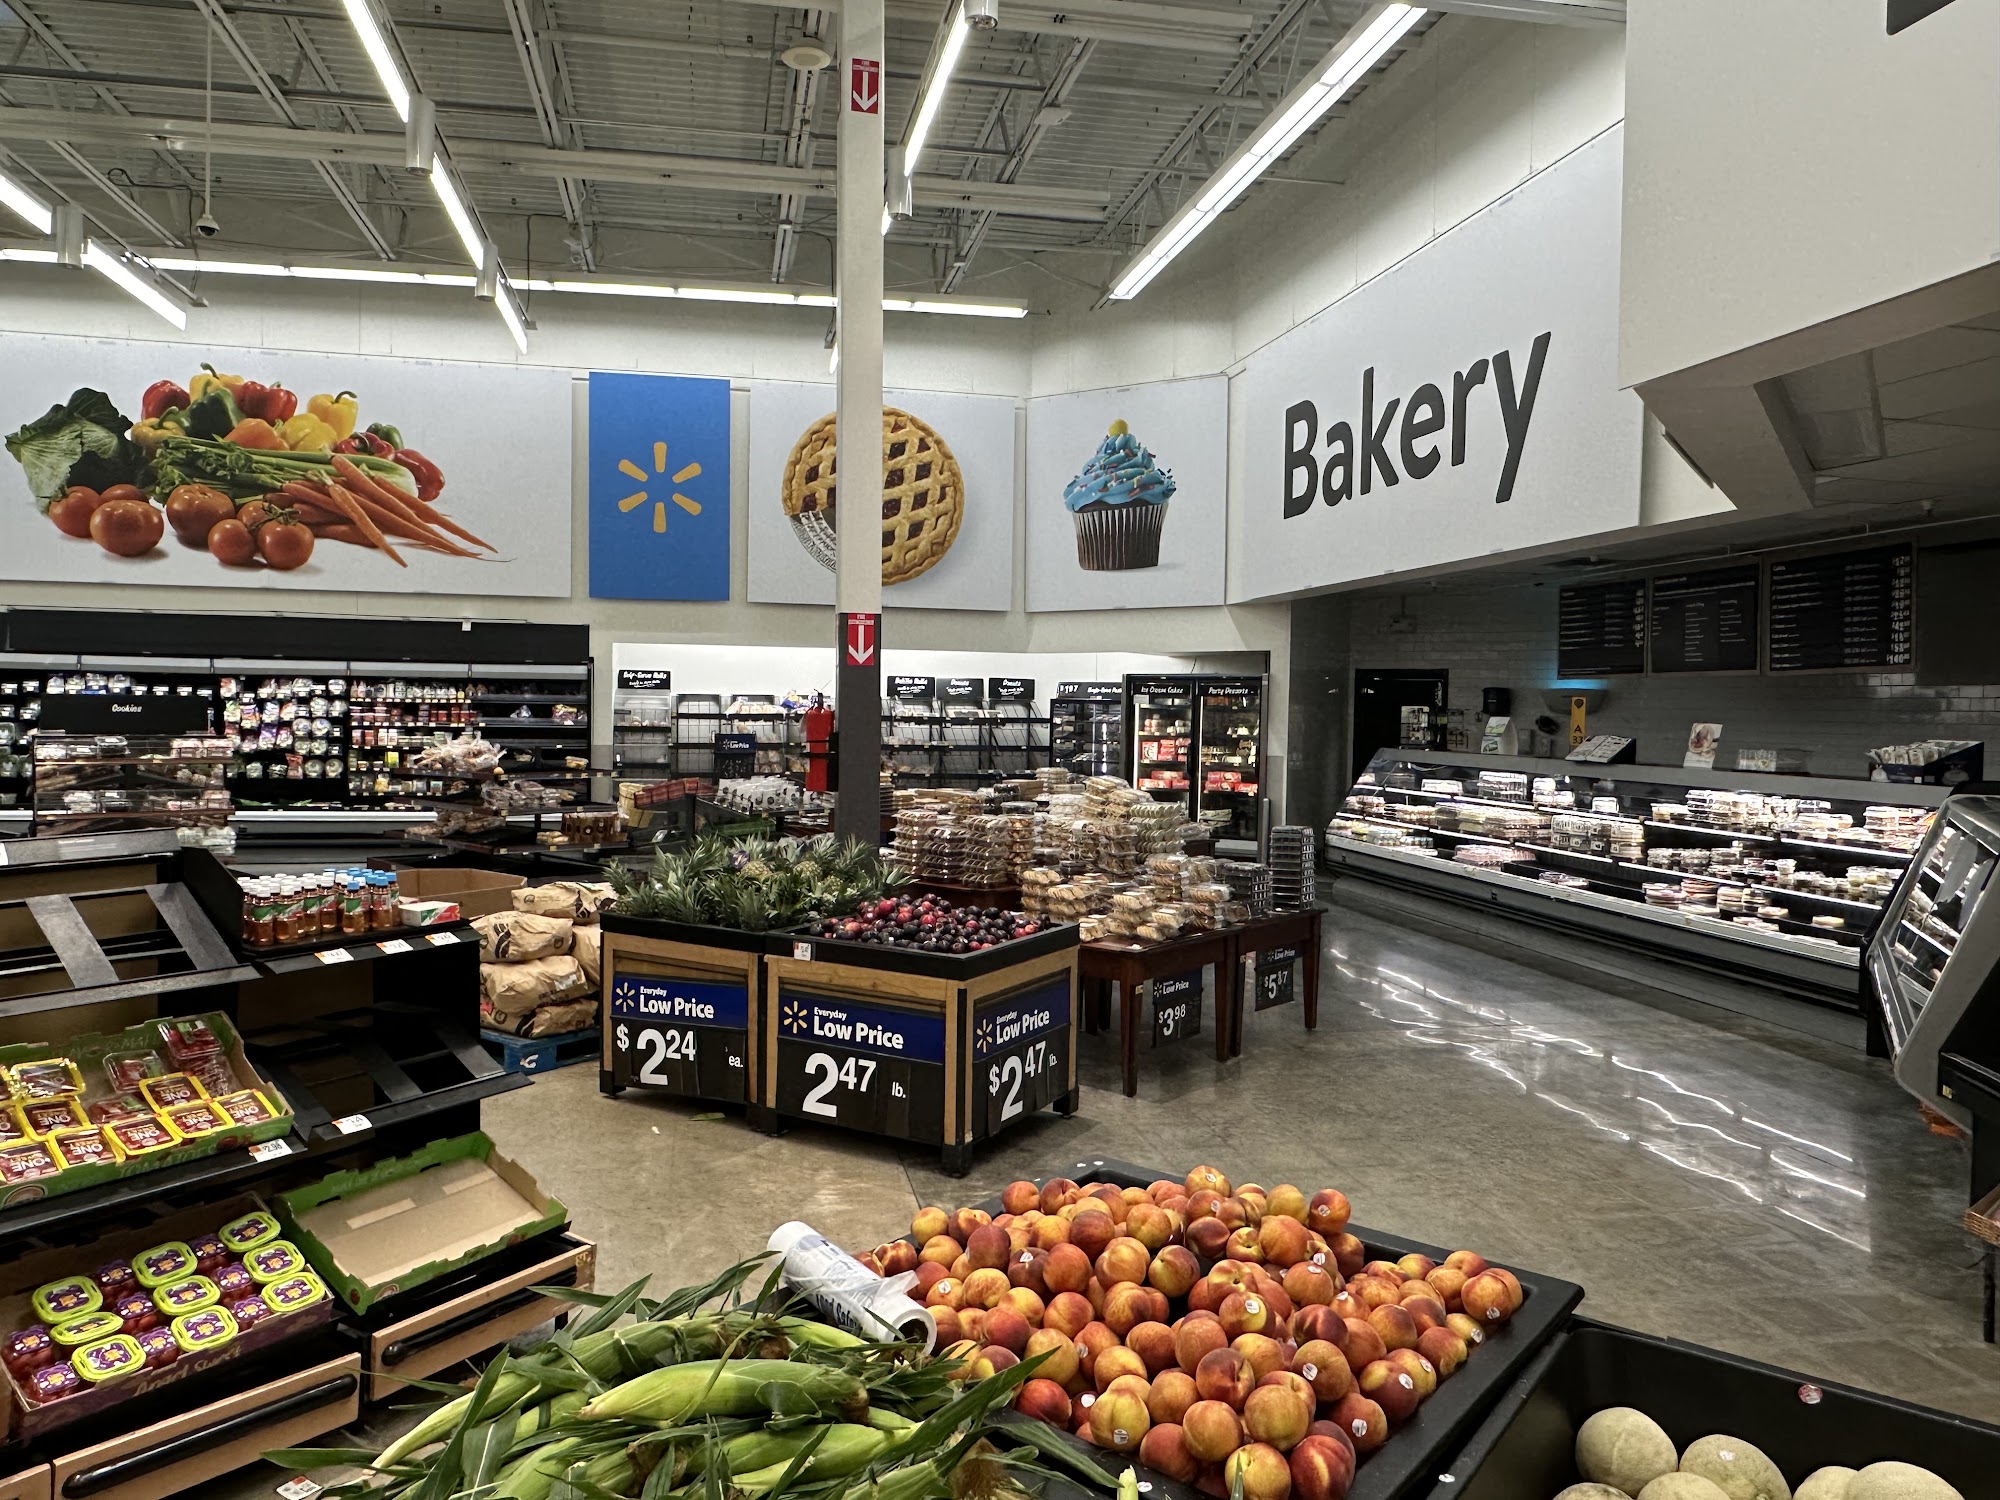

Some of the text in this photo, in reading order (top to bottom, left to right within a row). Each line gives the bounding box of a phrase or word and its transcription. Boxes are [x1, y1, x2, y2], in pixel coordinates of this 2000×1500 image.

[1283, 331, 1552, 520] Bakery
[112, 704, 142, 712] Cookies
[640, 986, 667, 997] Everyday
[640, 994, 714, 1019] Low Price
[813, 1006, 847, 1021] Everyday
[996, 1010, 1018, 1024] Everyday
[813, 1016, 904, 1049] Low Price
[996, 1009, 1050, 1044] Low Price
[728, 1055, 744, 1068] ea.
[164, 1089, 191, 1102] ONE
[891, 1081, 906, 1098] lb.
[232, 1106, 260, 1119] ONE
[39, 1114, 71, 1126] ONE
[185, 1115, 214, 1127] ONE
[131, 1129, 160, 1142] ONE
[72, 1143, 103, 1156] ONE
[12, 1157, 46, 1173] ONE
